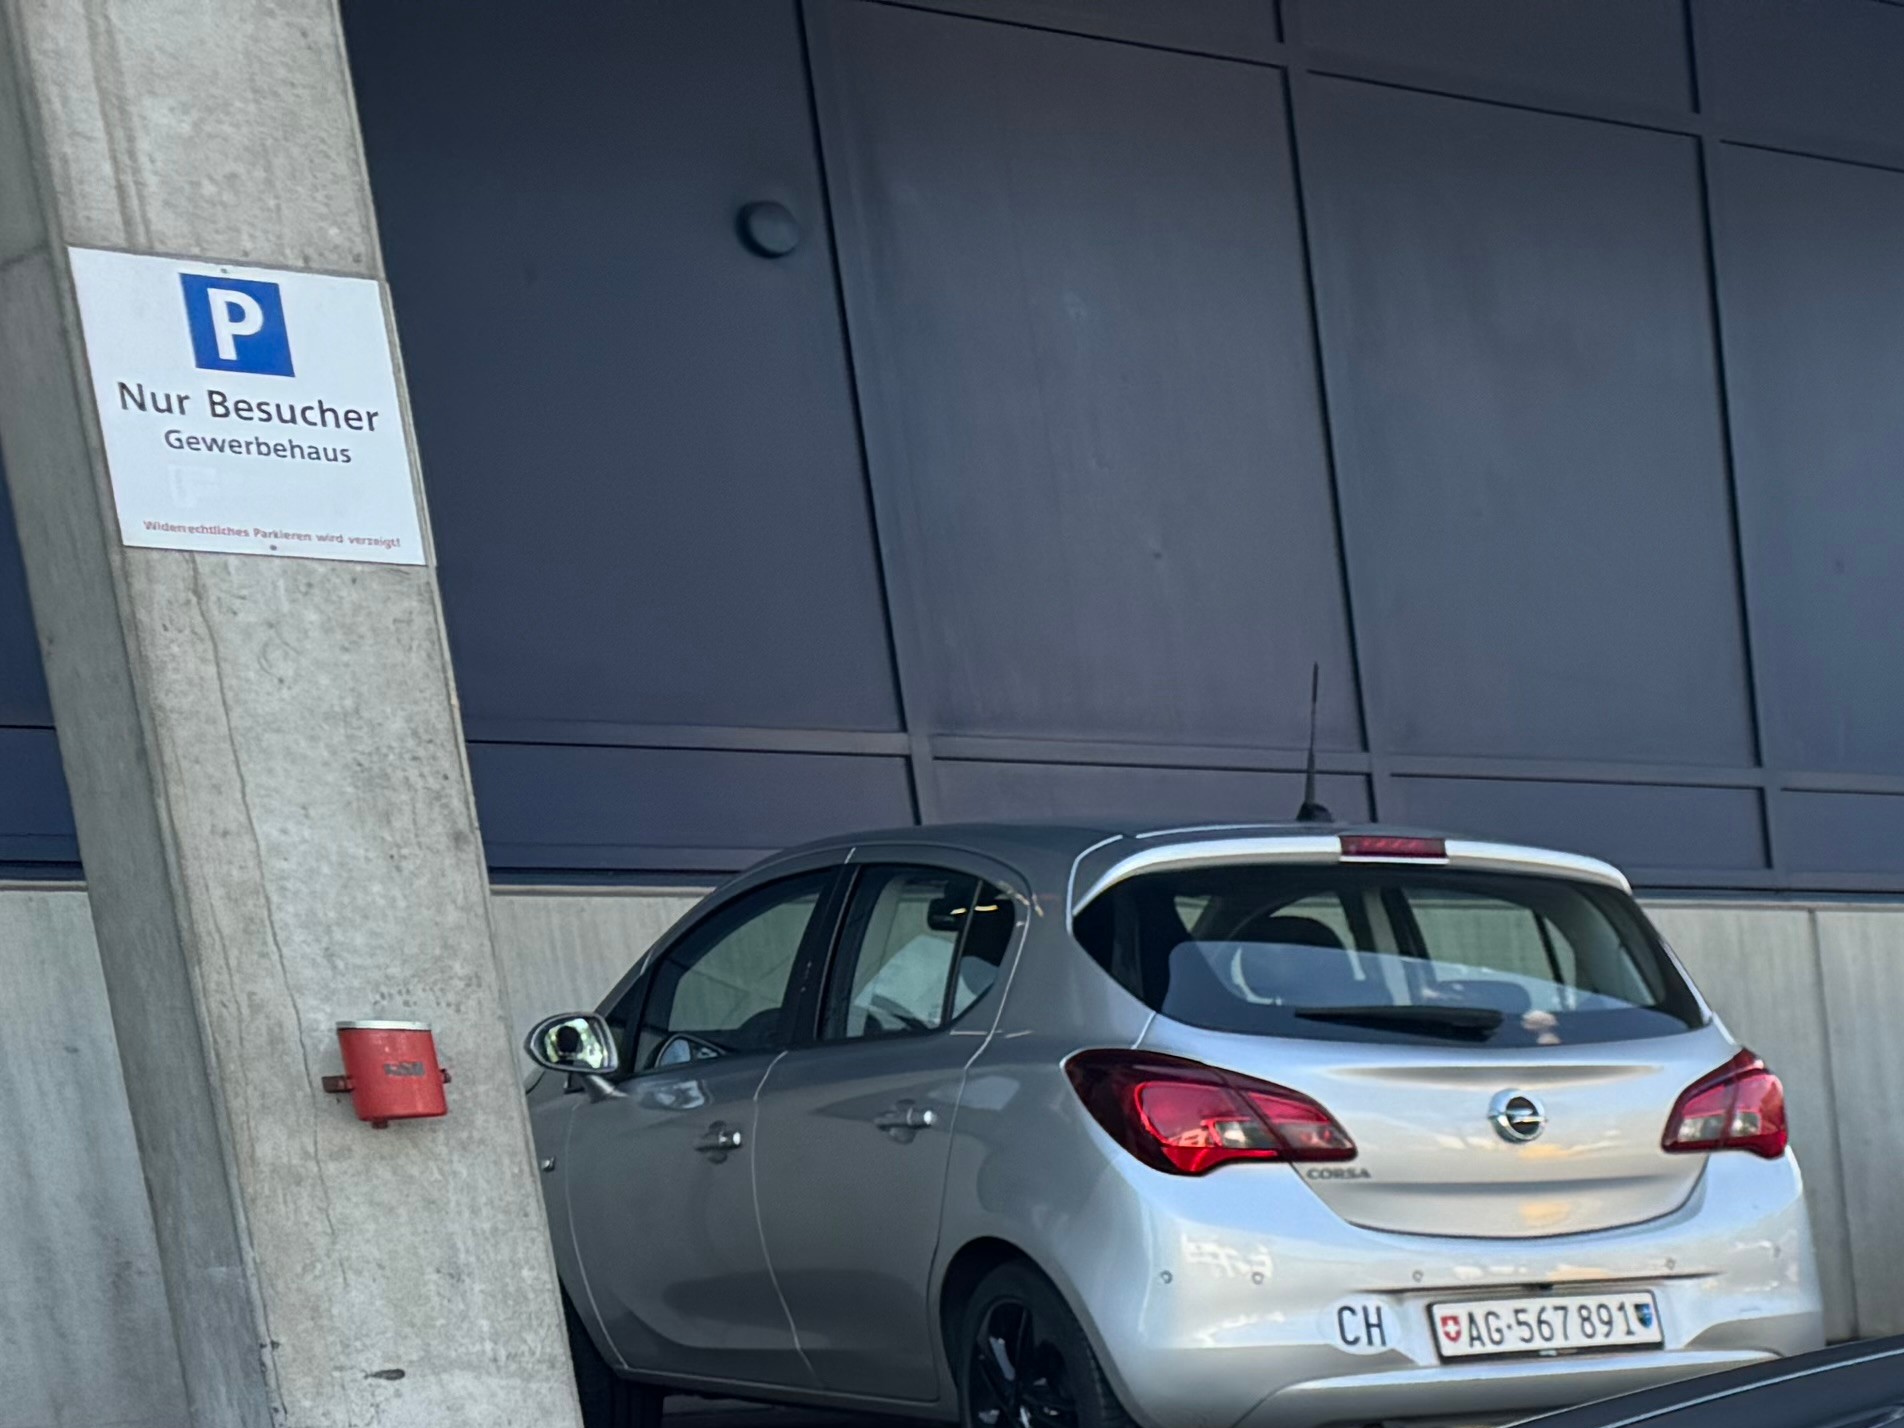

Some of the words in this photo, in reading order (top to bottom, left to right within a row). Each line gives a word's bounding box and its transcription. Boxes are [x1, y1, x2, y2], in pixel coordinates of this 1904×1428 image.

[206, 287, 264, 361] P
[117, 381, 191, 416] Nur
[206, 389, 380, 432] Besucher
[164, 429, 353, 464] Gewerbehaus
[253, 527, 312, 542] Parkieren
[315, 532, 344, 544] wird
[1307, 1167, 1371, 1181] CORSA
[1337, 1304, 1388, 1347] CH
